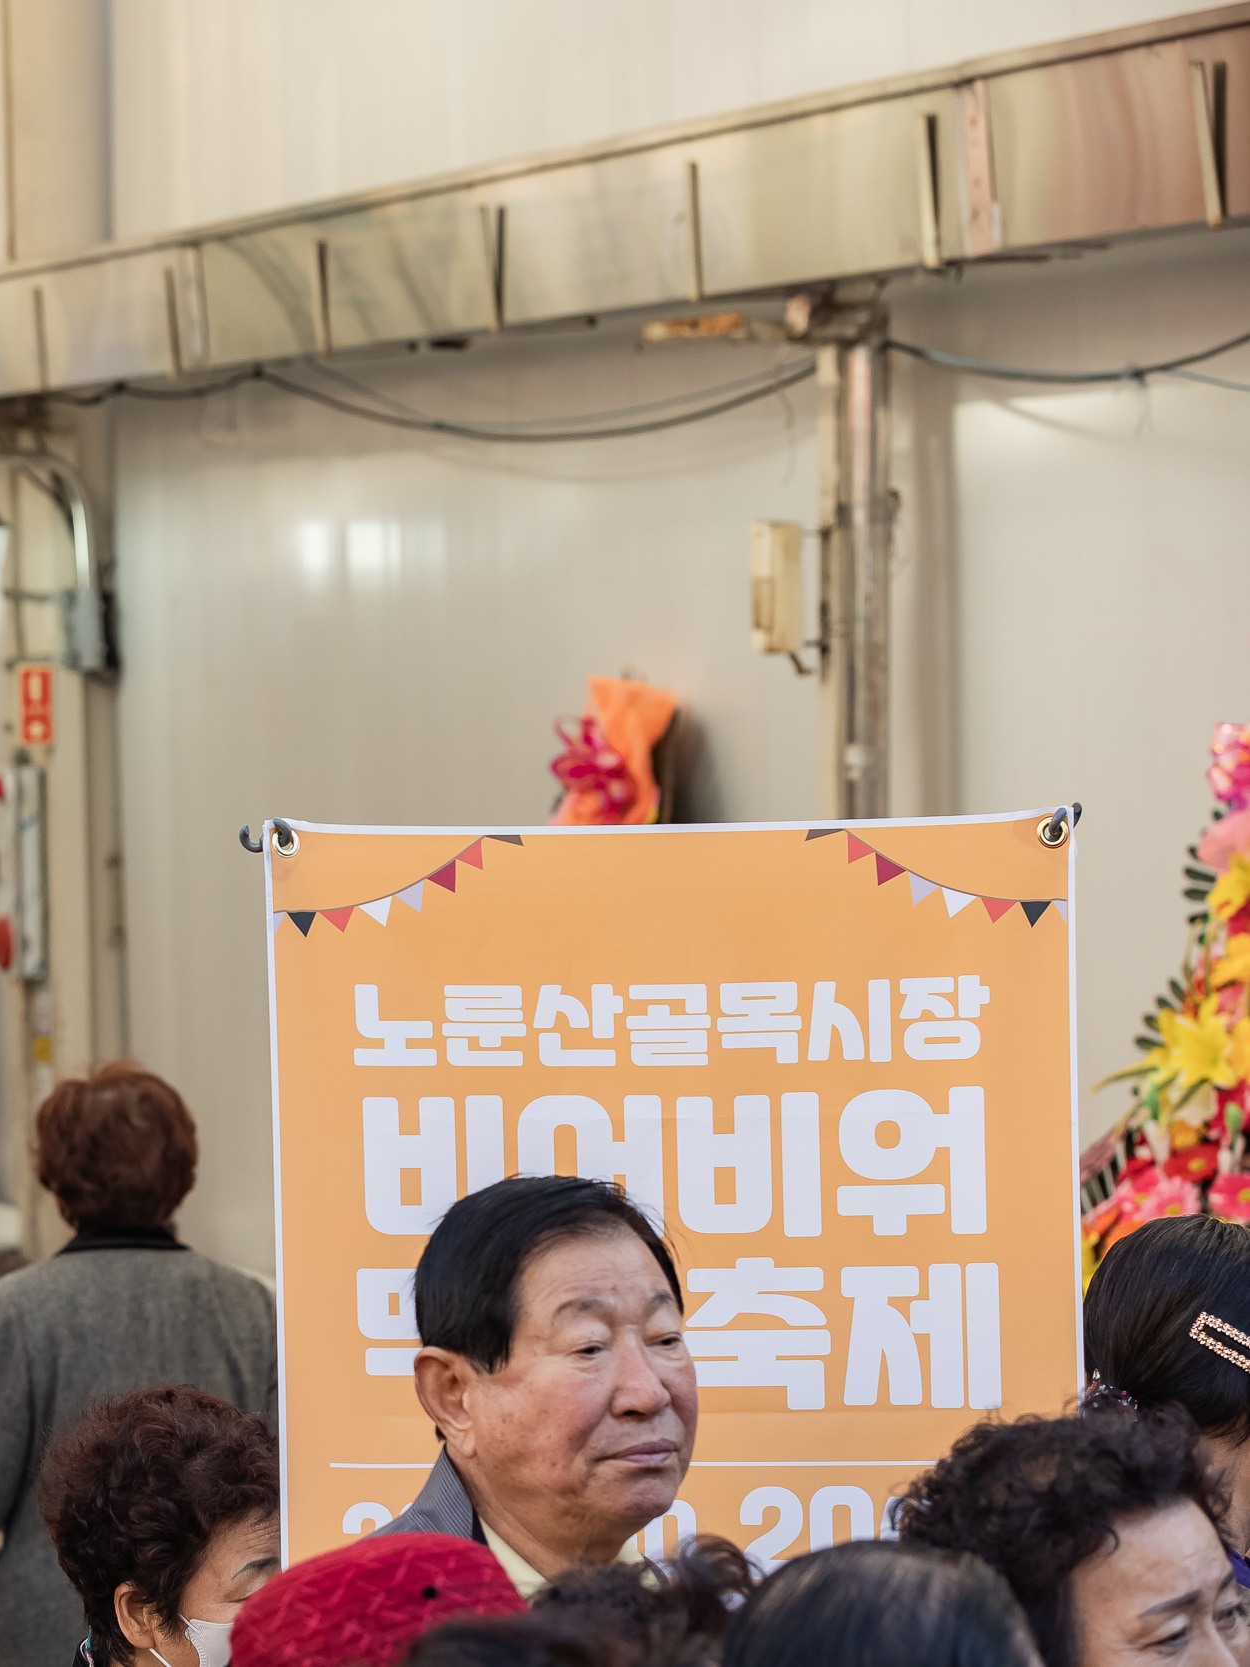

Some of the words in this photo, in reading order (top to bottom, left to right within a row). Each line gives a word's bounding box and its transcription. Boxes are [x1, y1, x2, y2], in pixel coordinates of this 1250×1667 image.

[354, 974, 991, 1067] 노룬산골목시장
[362, 1085, 987, 1238] 비어비워
[356, 1256, 1002, 1411] 축제
